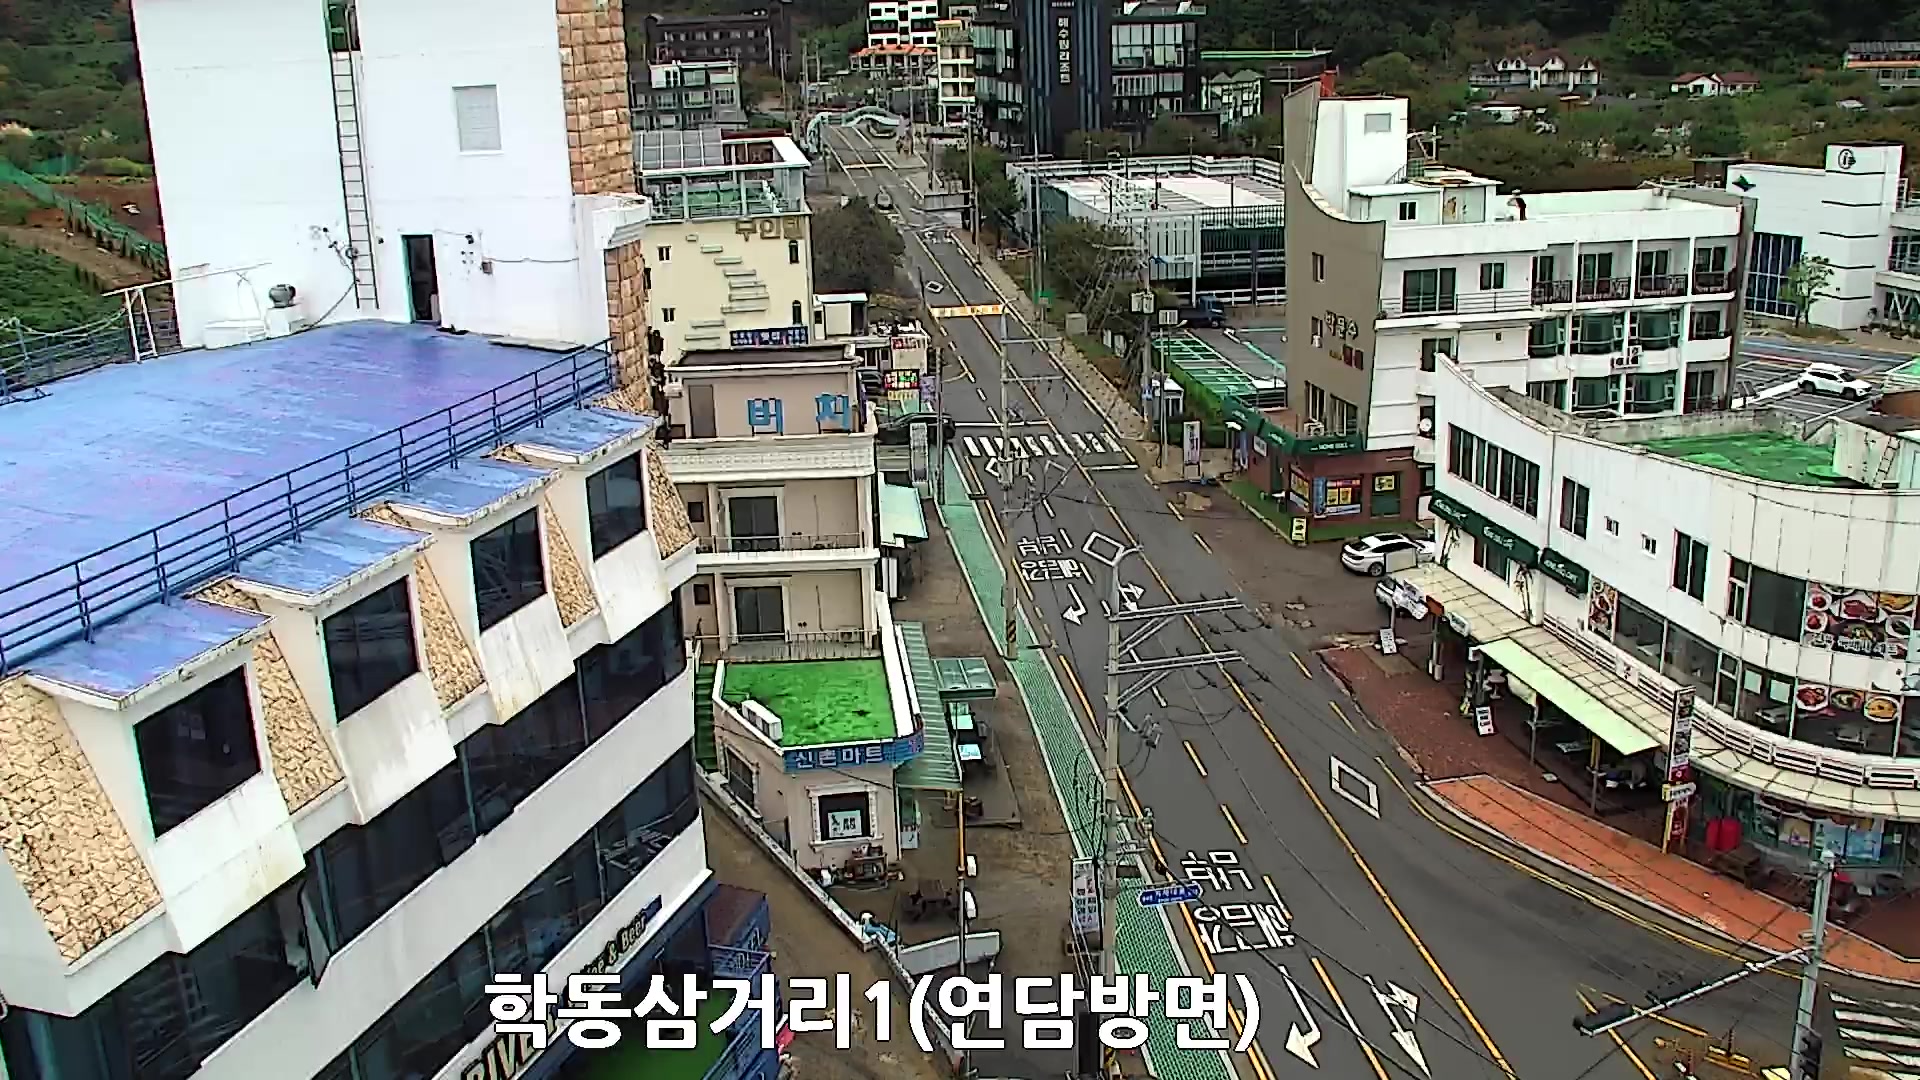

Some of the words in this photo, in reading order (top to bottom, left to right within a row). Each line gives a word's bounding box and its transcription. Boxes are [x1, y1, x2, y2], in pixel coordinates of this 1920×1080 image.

[1017, 535, 1062, 557] 남부
[1020, 559, 1082, 581] 해금강
[795, 745, 883, 769] 신촌마트
[1181, 851, 1254, 890] 남부
[621, 914, 647, 952] Beer
[1194, 904, 1295, 954] 해금강
